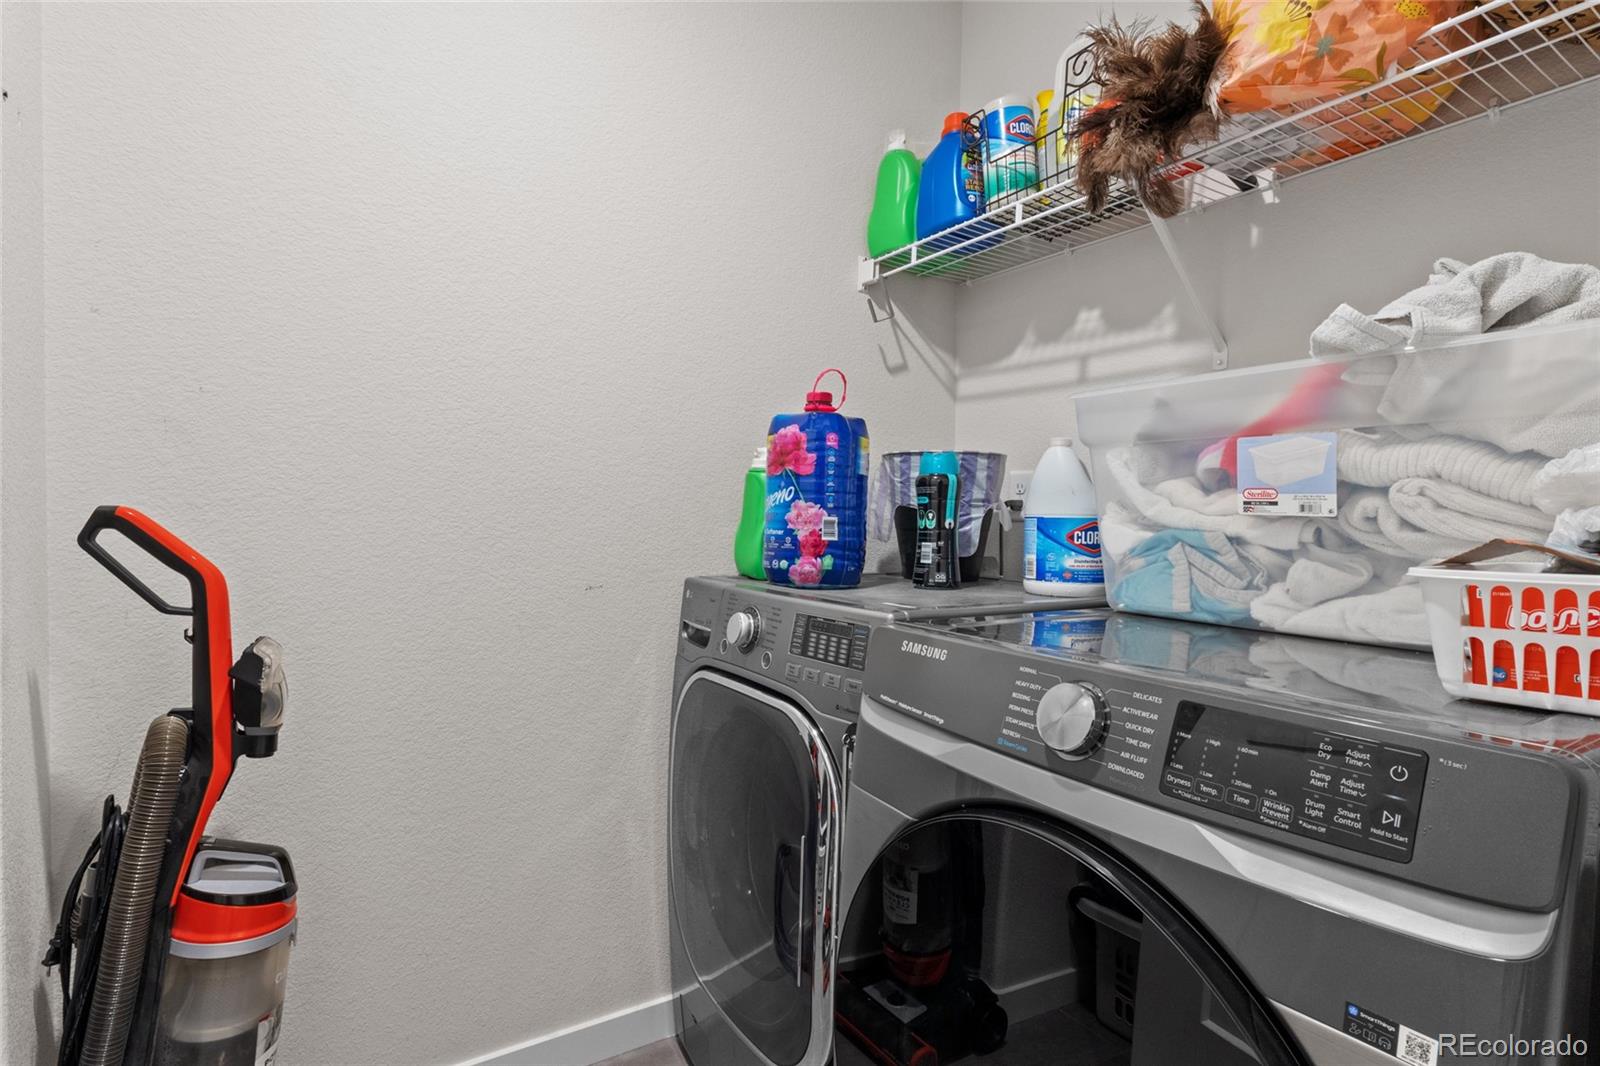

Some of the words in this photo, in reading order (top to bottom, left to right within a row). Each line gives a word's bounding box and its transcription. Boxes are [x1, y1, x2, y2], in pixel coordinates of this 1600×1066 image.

[1074, 530, 1100, 545] CLOR
[901, 640, 948, 661] SAMSUNG
[1019, 666, 1038, 675] NORMAL
[1015, 680, 1029, 688] HEAVY
[1029, 683, 1042, 691] DUTY
[1132, 691, 1162, 704] DELICATES
[1122, 706, 1159, 720] ACTIVEWEAR
[1125, 722, 1142, 732] QUICK
[1142, 727, 1155, 735] DRY
[1125, 737, 1139, 746] TIME
[1139, 741, 1151, 750] DRY
[1319, 742, 1333, 751] Eco
[1120, 751, 1130, 759] AIR
[1130, 755, 1148, 764] FLUFF
[1317, 750, 1332, 760] Dry
[1346, 749, 1371, 760] Adjust
[1345, 756, 1363, 767] Time
[1107, 762, 1145, 779] DOWNLOADED
[1310, 769, 1331, 781] Damp
[1167, 774, 1191, 787] Dryness
[1309, 778, 1328, 789] Alert
[1340, 778, 1365, 790] Adjust
[1268, 789, 1278, 797] On
[1339, 785, 1358, 796] Time
[1233, 793, 1250, 805] Time
[1305, 798, 1325, 810] Drum
[1263, 799, 1290, 813] Wrinkle
[1304, 806, 1324, 818] Light
[1262, 806, 1290, 820] Prevent
[1337, 807, 1361, 820] Smart
[1333, 815, 1362, 829] Control
[1370, 827, 1385, 836] Hold
[1393, 833, 1409, 843] Start
